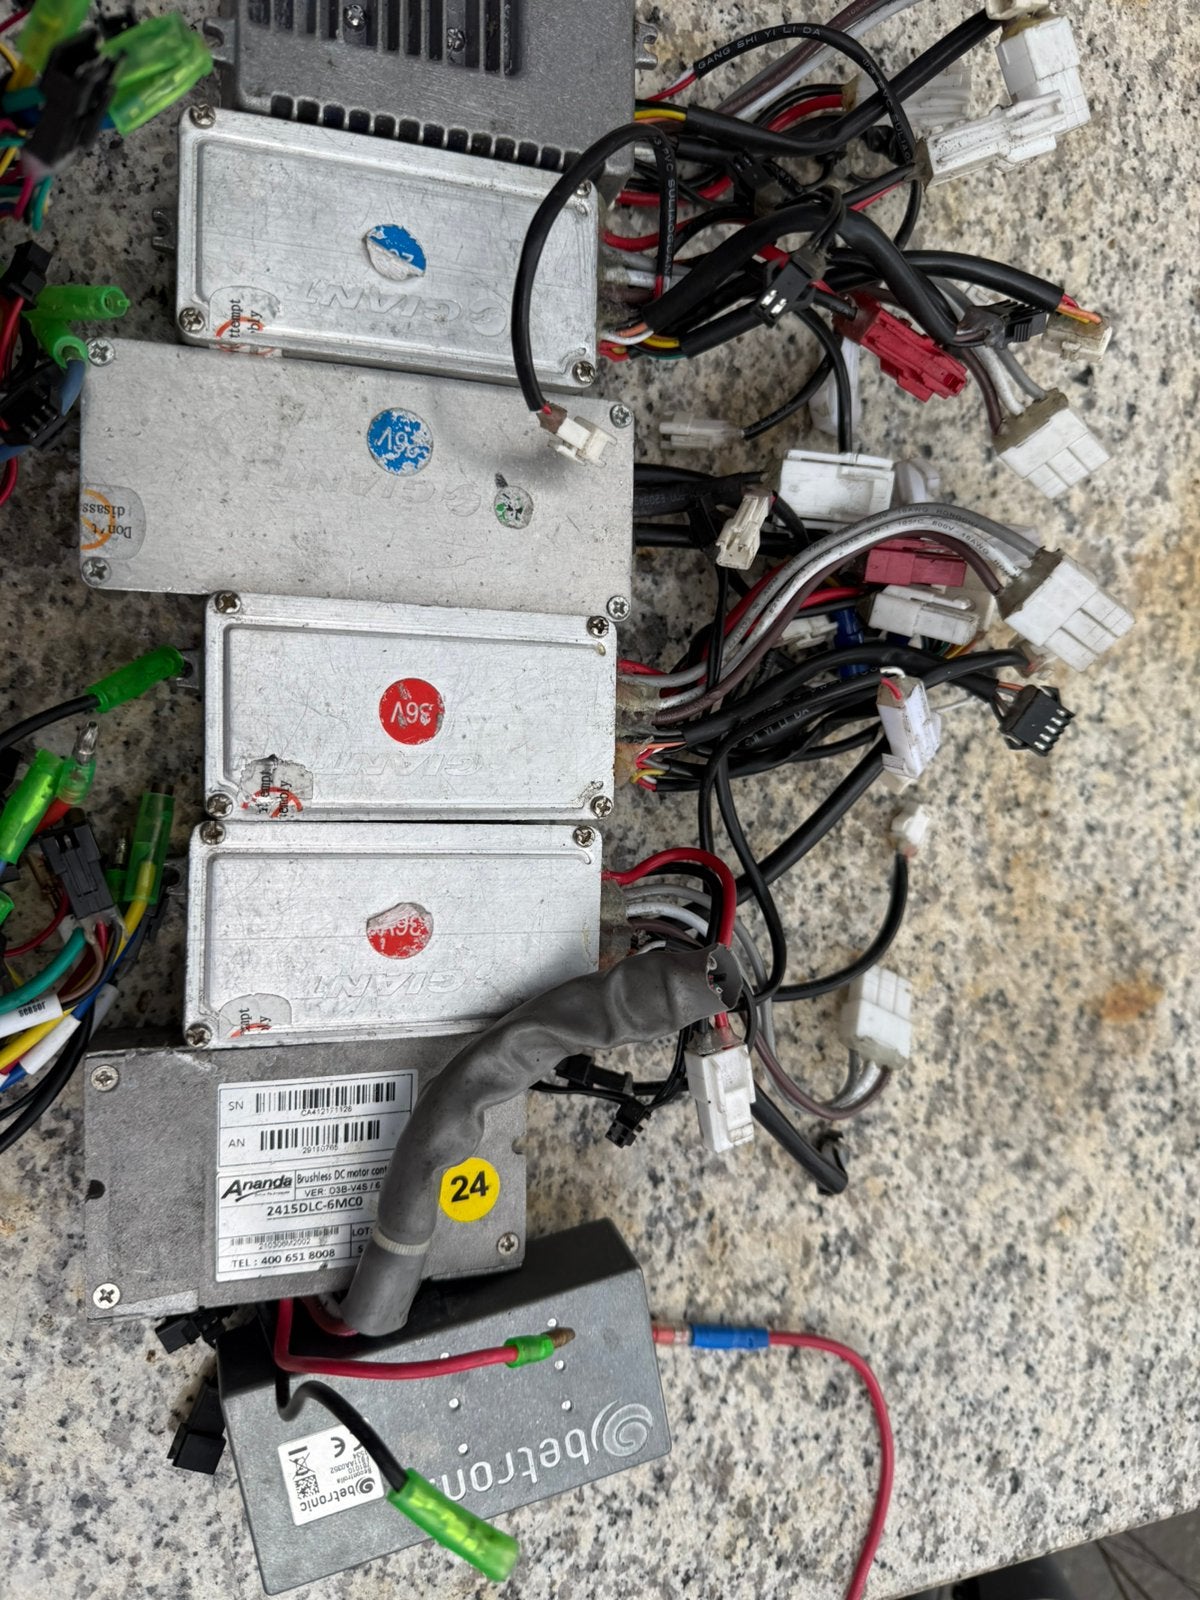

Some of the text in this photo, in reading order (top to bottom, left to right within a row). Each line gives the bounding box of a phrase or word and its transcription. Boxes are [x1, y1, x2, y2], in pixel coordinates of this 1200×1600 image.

[697, 26, 822, 70] GANG SHI YI LI DA
[893, 114, 912, 162] SULIAO
[662, 147, 675, 172] PVC
[306, 279, 463, 322] GIANT
[229, 299, 243, 338] ttempt
[390, 701, 434, 727] 36V
[313, 752, 483, 777] GIANT
[291, 969, 467, 1000] GIANT
[228, 1101, 245, 1111] SN
[228, 1138, 246, 1149] AN
[221, 1174, 293, 1200] Ananda
[297, 1170, 333, 1185] Brushless
[333, 1168, 346, 1180] DC
[346, 1168, 370, 1179] motor
[450, 1170, 490, 1203] 24
[304, 1187, 328, 1198] VER:
[352, 1226, 374, 1238] LOT:
[232, 1258, 251, 1268] TEL
[260, 1254, 282, 1265] 400
[284, 1252, 306, 1262] 651
[308, 1248, 336, 1260] 8008
[430, 1427, 591, 1502] betron
[299, 1484, 357, 1512] betronic
